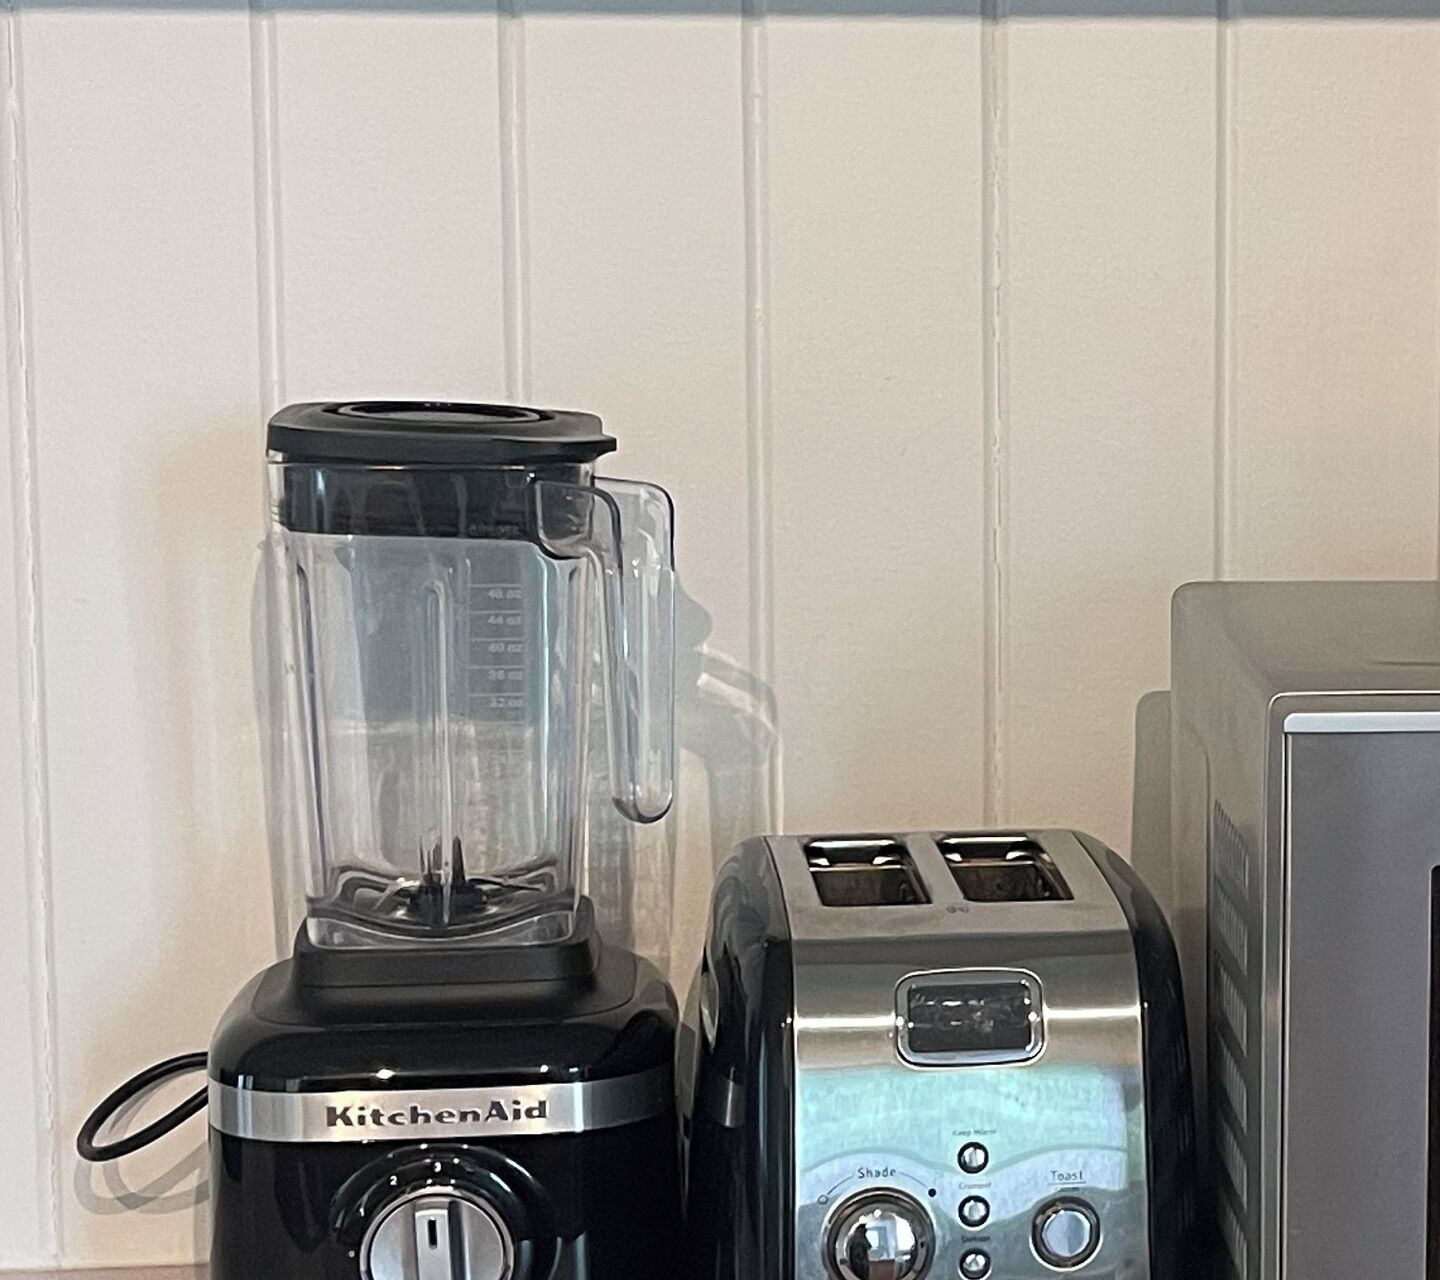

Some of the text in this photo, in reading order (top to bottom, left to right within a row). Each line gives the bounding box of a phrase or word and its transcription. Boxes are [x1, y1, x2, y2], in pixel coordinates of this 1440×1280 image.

[326, 1100, 548, 1127] KitchenAid
[857, 1166, 896, 1179] Shade
[1051, 1170, 1083, 1181] Toast
[389, 1175, 398, 1186] 2
